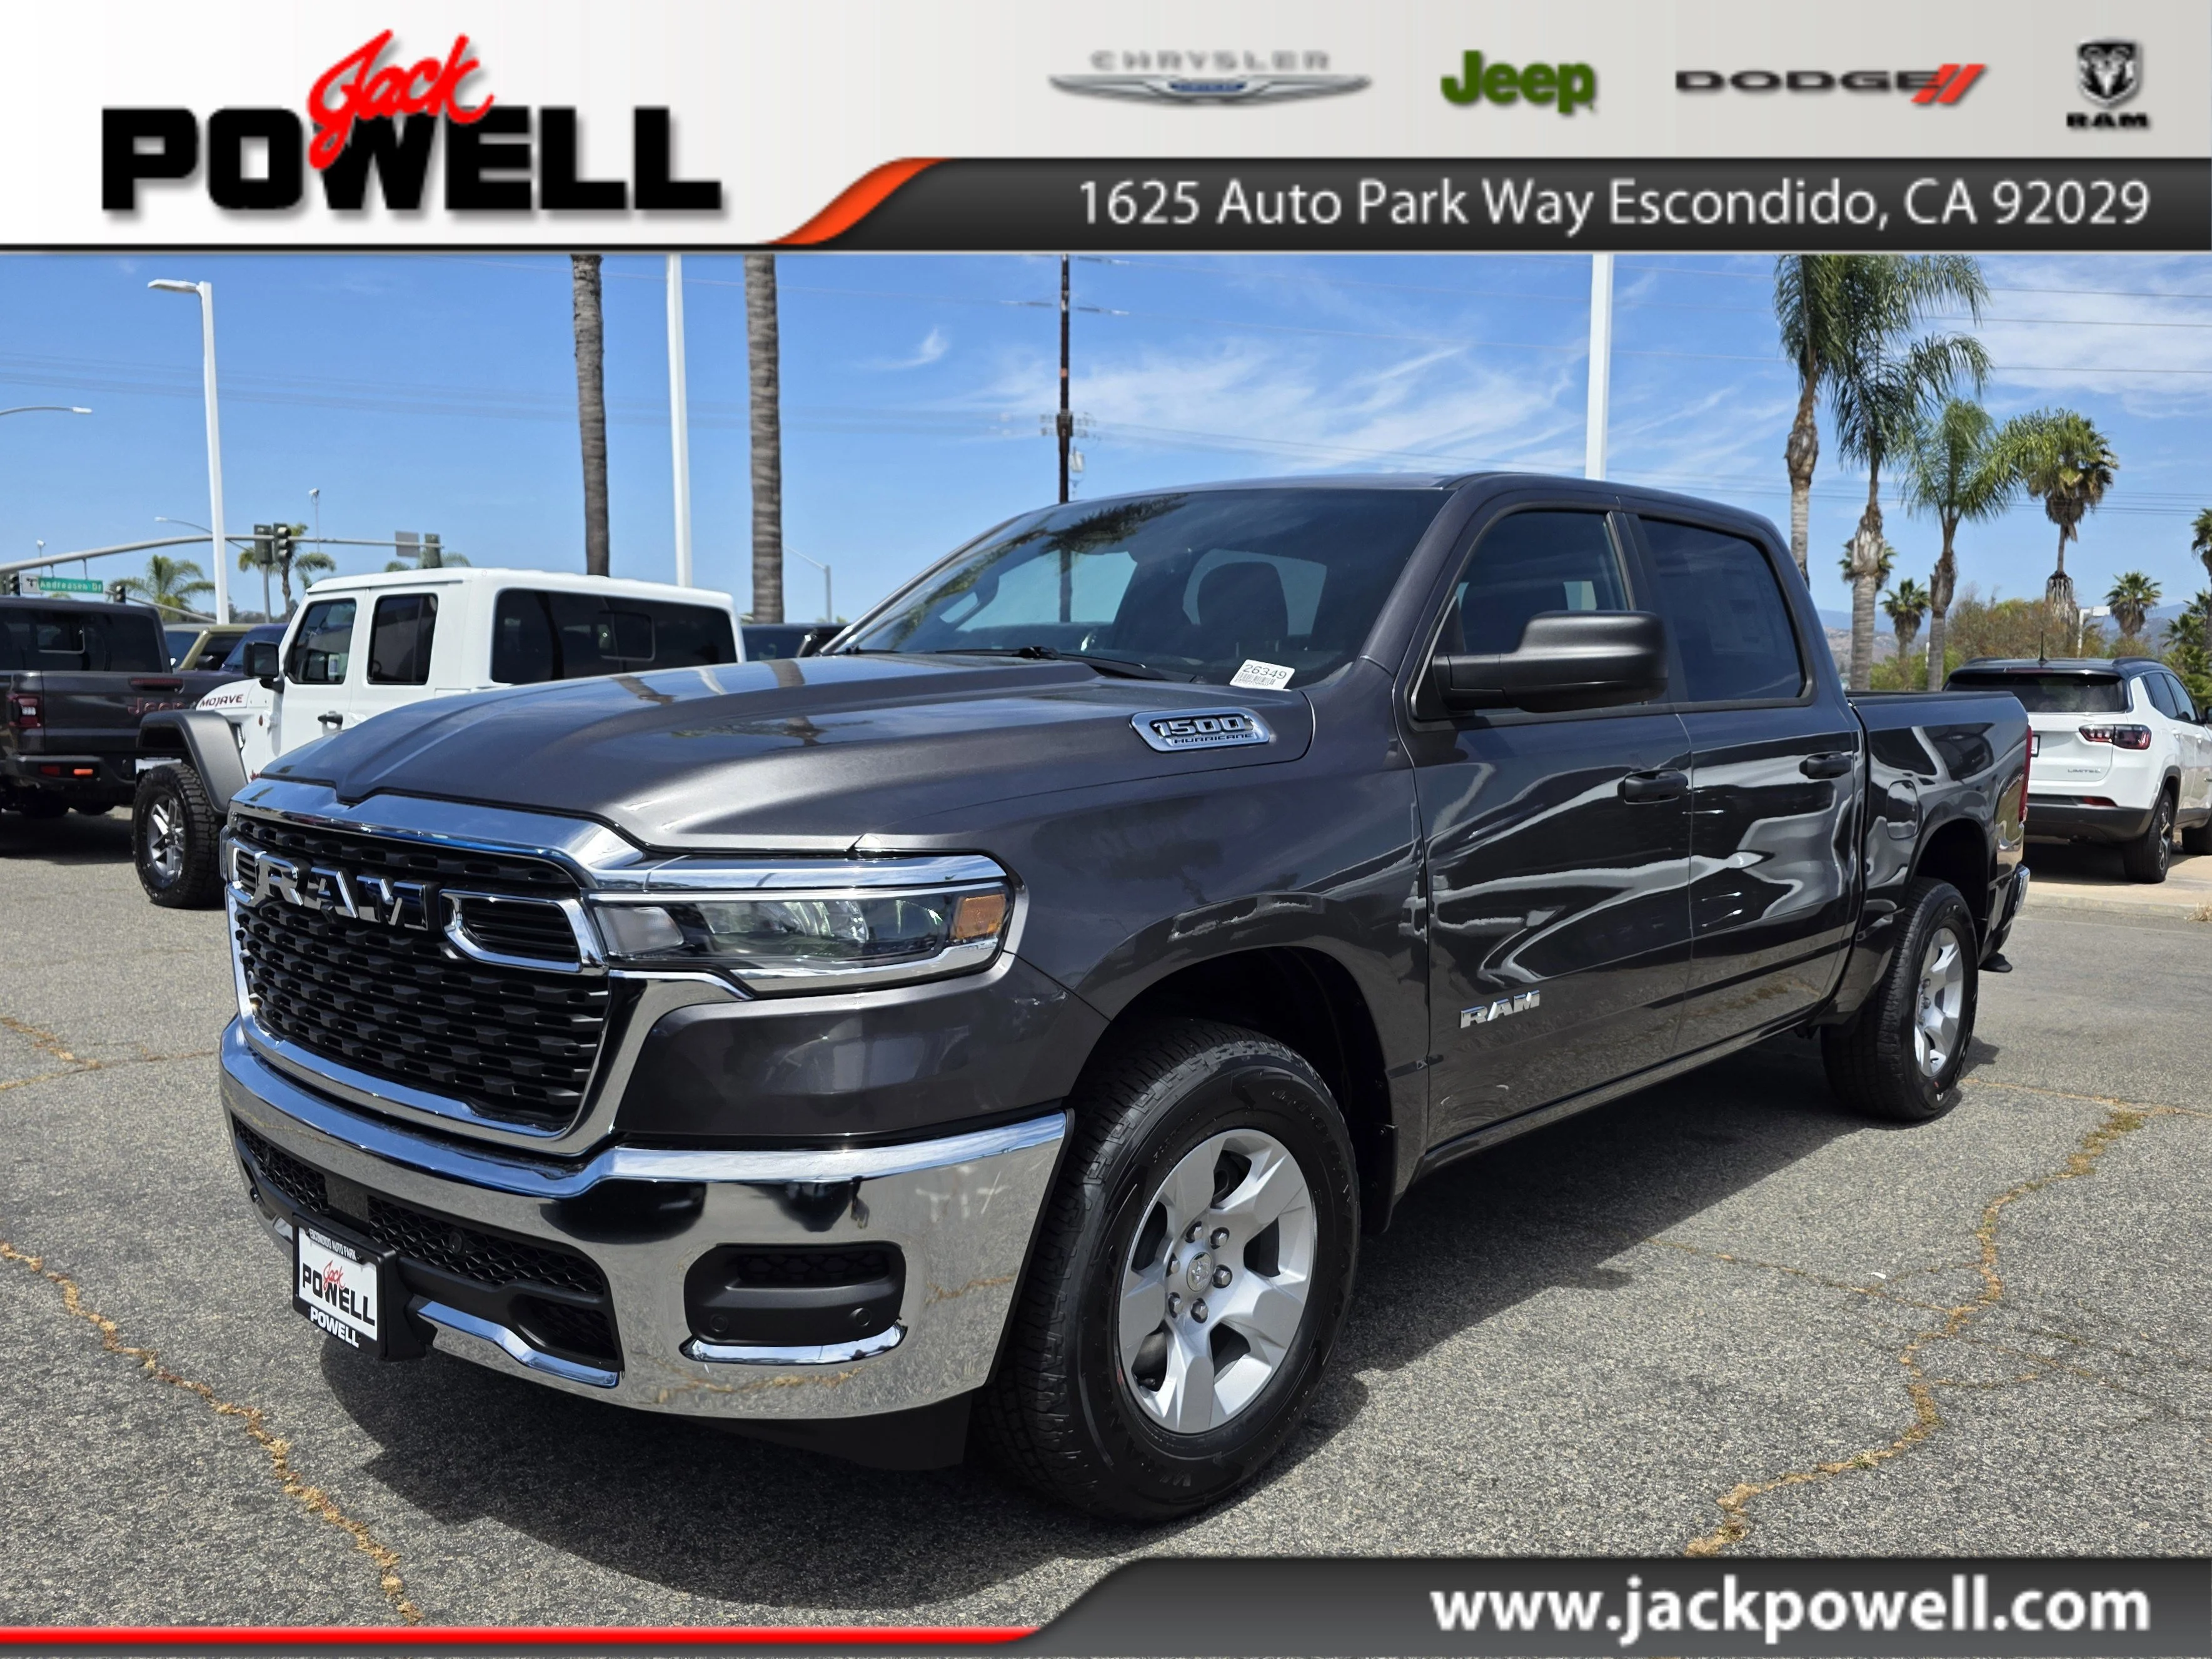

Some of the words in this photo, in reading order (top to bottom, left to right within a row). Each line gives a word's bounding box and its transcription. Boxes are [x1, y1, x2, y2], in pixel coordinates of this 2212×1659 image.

[1243, 664, 1287, 680] 26349
[199, 694, 244, 708] MOJAVE
[1154, 716, 1245, 737] 1500
[1174, 733, 1253, 744] HURRICANE
[254, 854, 429, 931] RAM
[1460, 989, 1541, 1029] RAM
[332, 1240, 344, 1255] AUTO
[343, 1246, 357, 1261] PARK
[323, 1260, 346, 1291] Jack
[303, 1263, 375, 1326] POWELL
[311, 1306, 359, 1348] POWELL
